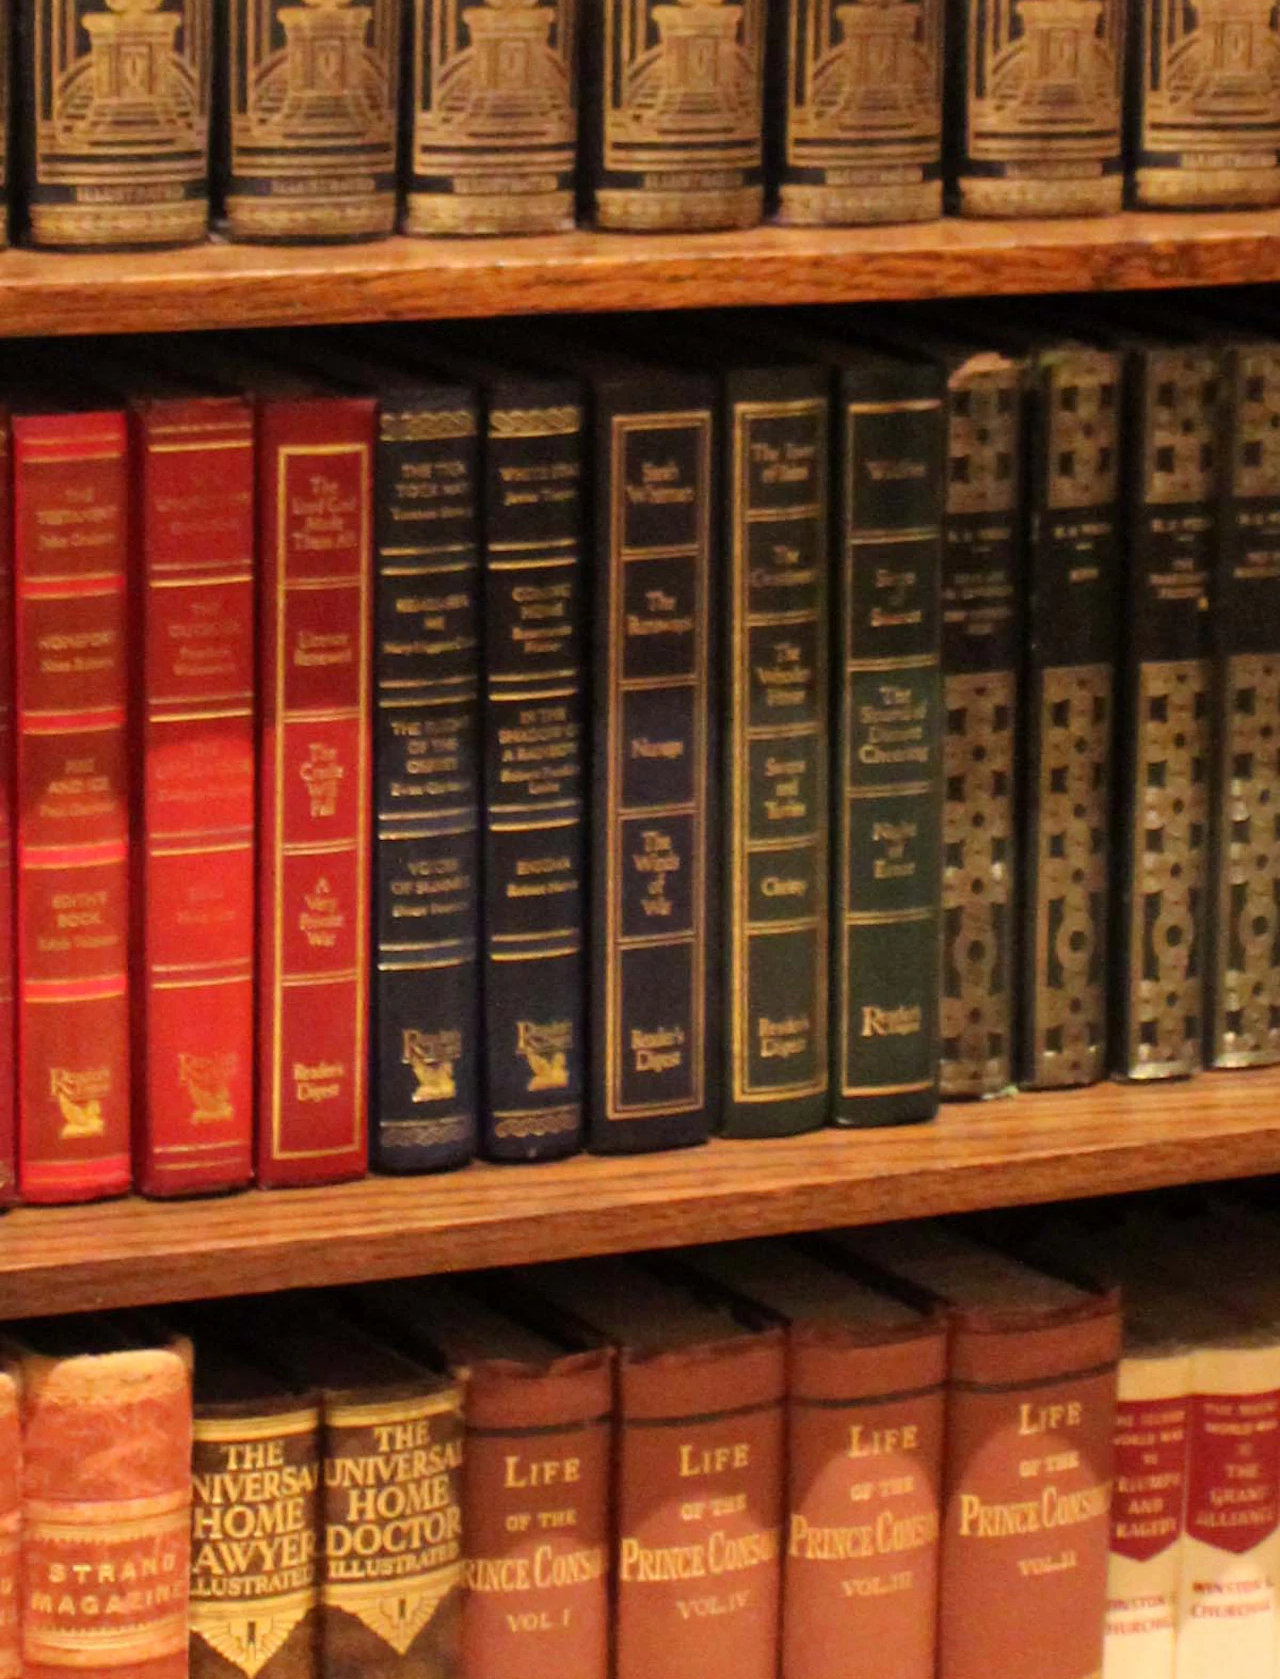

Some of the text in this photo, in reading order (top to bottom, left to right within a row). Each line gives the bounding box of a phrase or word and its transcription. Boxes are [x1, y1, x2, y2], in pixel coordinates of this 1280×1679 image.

[1018, 1402, 1082, 1435] LIFE
[375, 1420, 430, 1452] THE
[849, 1425, 917, 1458] LIFE
[224, 1441, 284, 1471] THE
[504, 1456, 581, 1488] LIFE
[678, 1444, 749, 1477] LIFE
[1019, 1450, 1079, 1477] OF THE
[192, 1461, 318, 1504] NIVERSA
[347, 1473, 450, 1522] HOME
[850, 1476, 915, 1501] OF THE
[194, 1497, 305, 1540] HOME
[506, 1509, 577, 1532] OF THE
[681, 1494, 747, 1521] OF THE
[958, 1493, 1040, 1538] PRINCE
[1128, 1497, 1163, 1516] AND
[326, 1505, 462, 1557] DOCTOR
[790, 1513, 873, 1559] PRINCE
[48, 1552, 176, 1584] STRAND
[193, 1530, 316, 1575] AWYER
[328, 1541, 460, 1580] ILLUSTRATED
[621, 1537, 705, 1582] PRINCE
[31, 1579, 183, 1615] MAGAZINE
